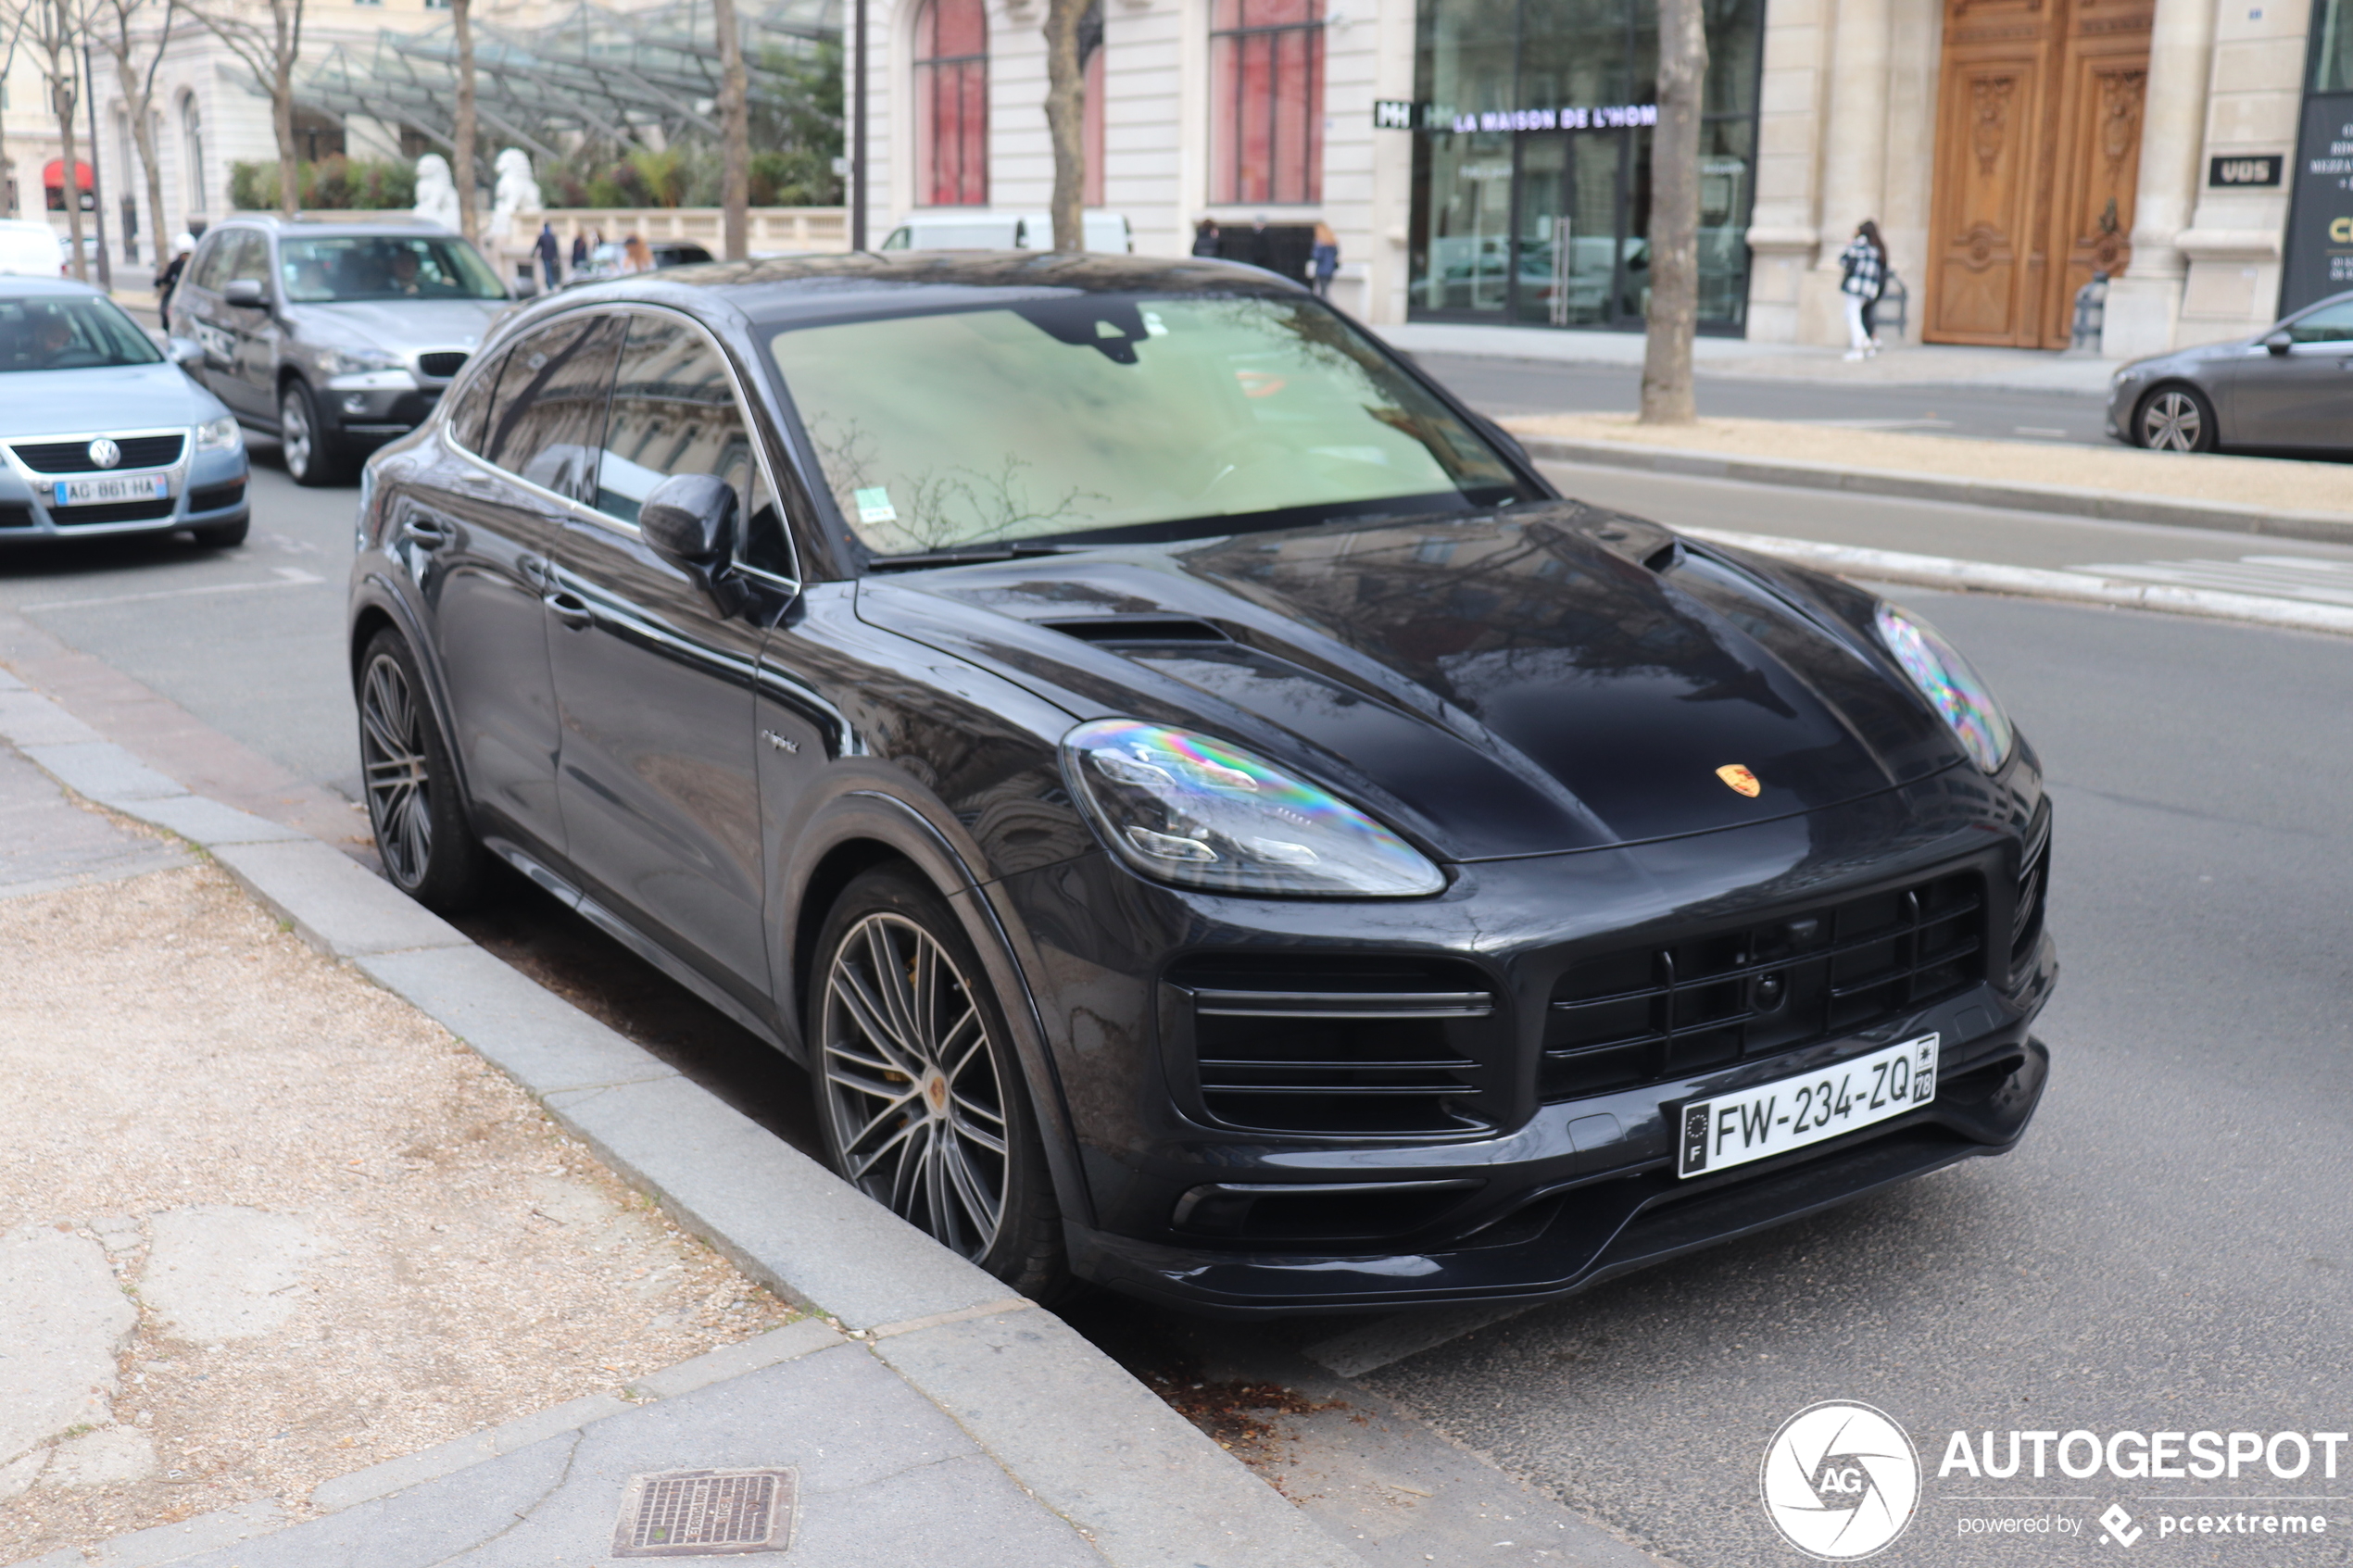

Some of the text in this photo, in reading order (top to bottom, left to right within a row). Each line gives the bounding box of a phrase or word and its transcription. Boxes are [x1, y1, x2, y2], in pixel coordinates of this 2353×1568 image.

[1453, 113, 1478, 132] LA
[1480, 109, 1556, 132] MAISON
[1560, 107, 1589, 129] DE
[1716, 1056, 1932, 1156] FW-234-ZQ 78
[1690, 1145, 1702, 1161] F
